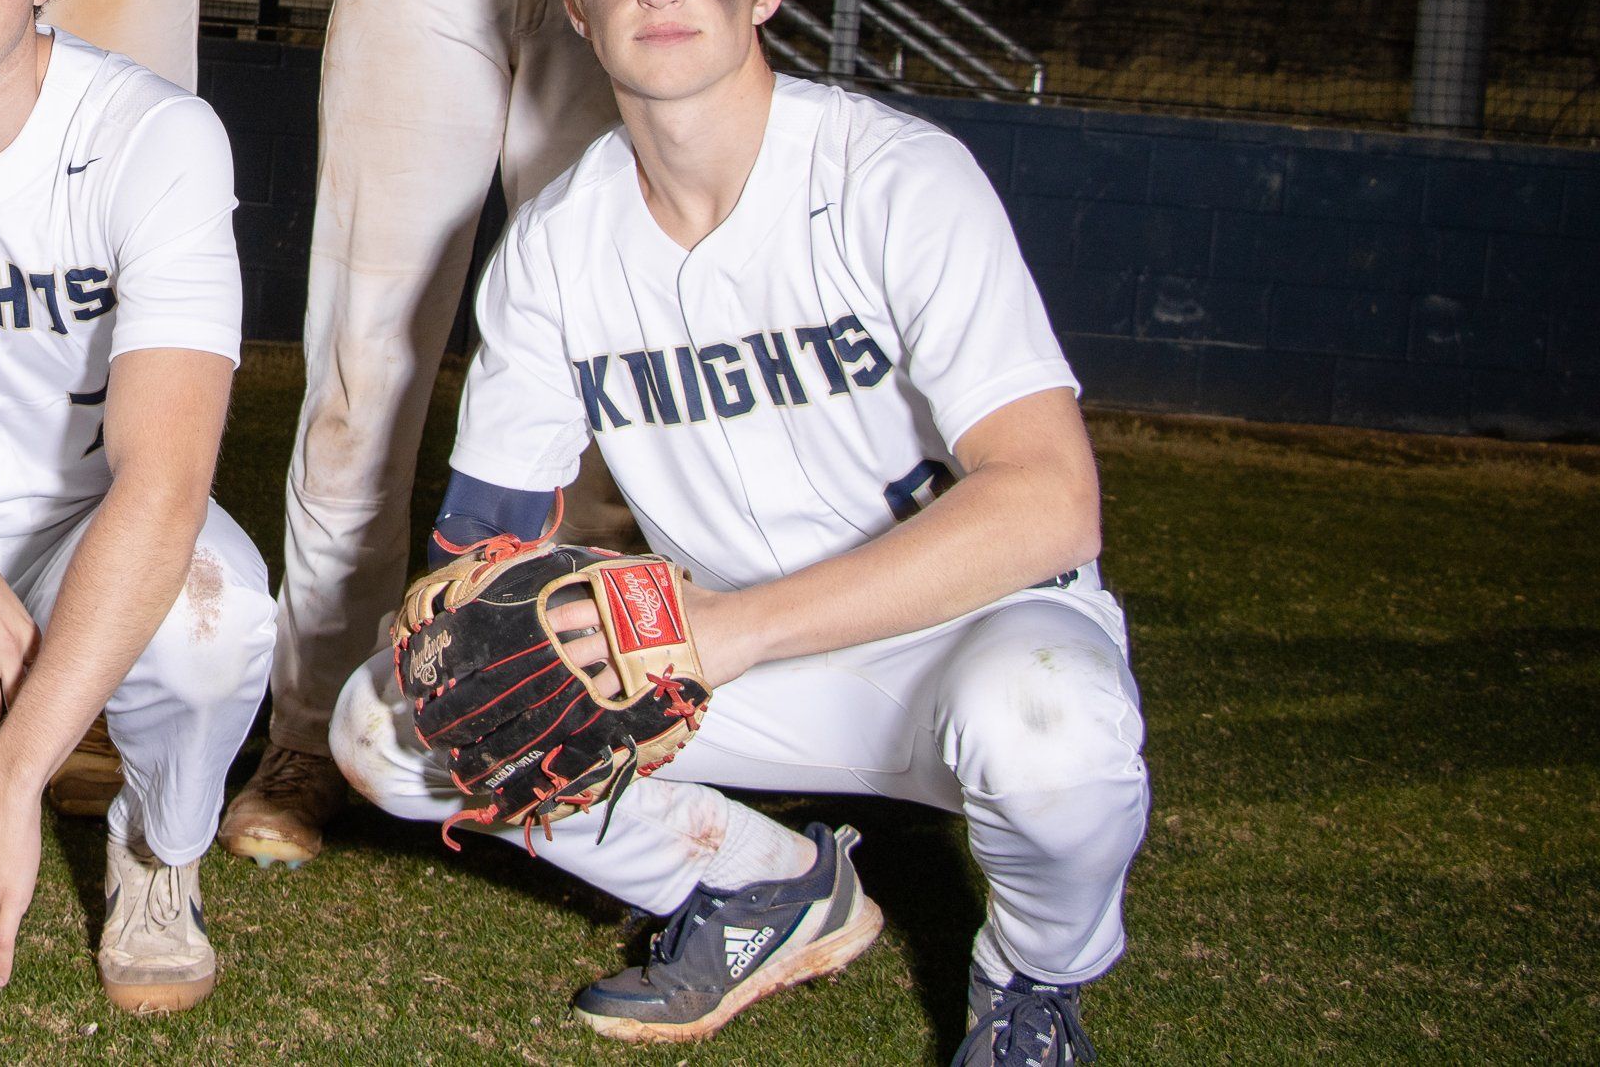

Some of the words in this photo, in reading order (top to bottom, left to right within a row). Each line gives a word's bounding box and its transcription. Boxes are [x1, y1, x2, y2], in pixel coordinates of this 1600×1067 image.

[571, 314, 894, 433] KNIGHTS
[623, 571, 662, 640] Rawlings
[409, 629, 452, 686] Rawlings
[729, 926, 775, 979] adidas
